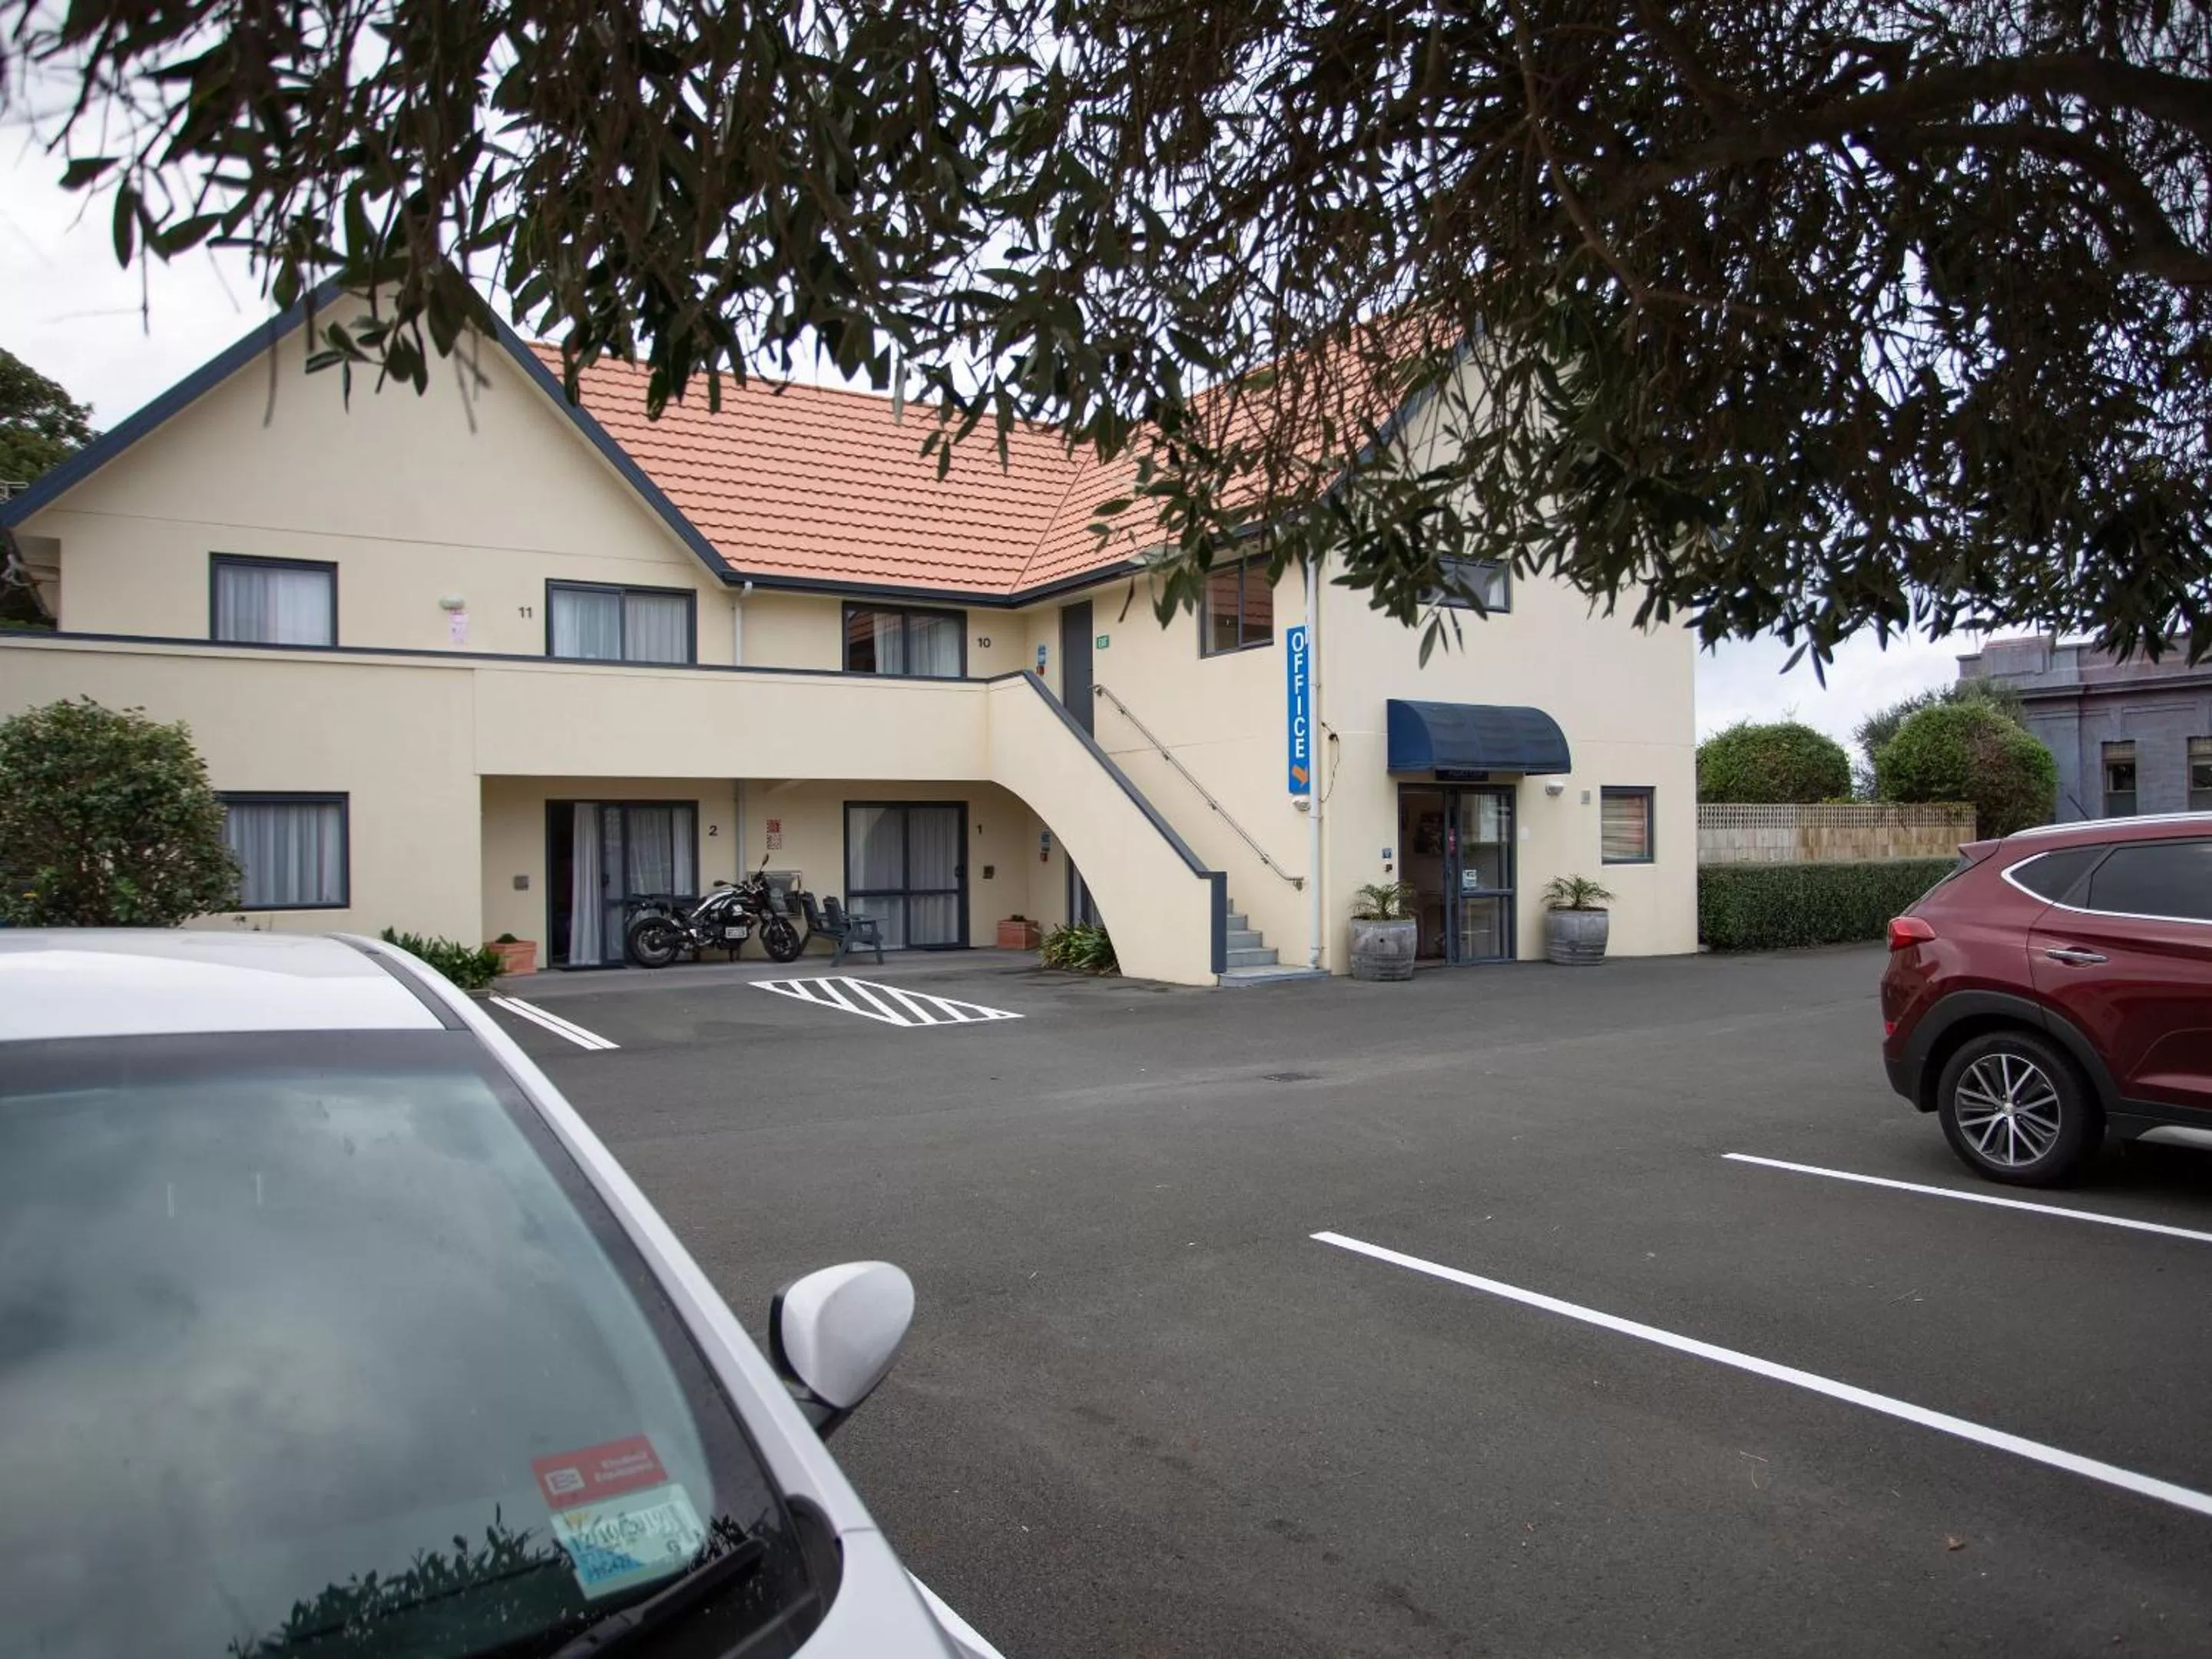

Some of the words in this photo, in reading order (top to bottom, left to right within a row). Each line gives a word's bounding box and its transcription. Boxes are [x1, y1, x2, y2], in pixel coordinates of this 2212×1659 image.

[518, 607, 531, 618] 11
[977, 637, 991, 647] 10
[1291, 632, 1305, 758] OFFICE
[708, 825, 717, 836] 2
[977, 823, 982, 834] 1
